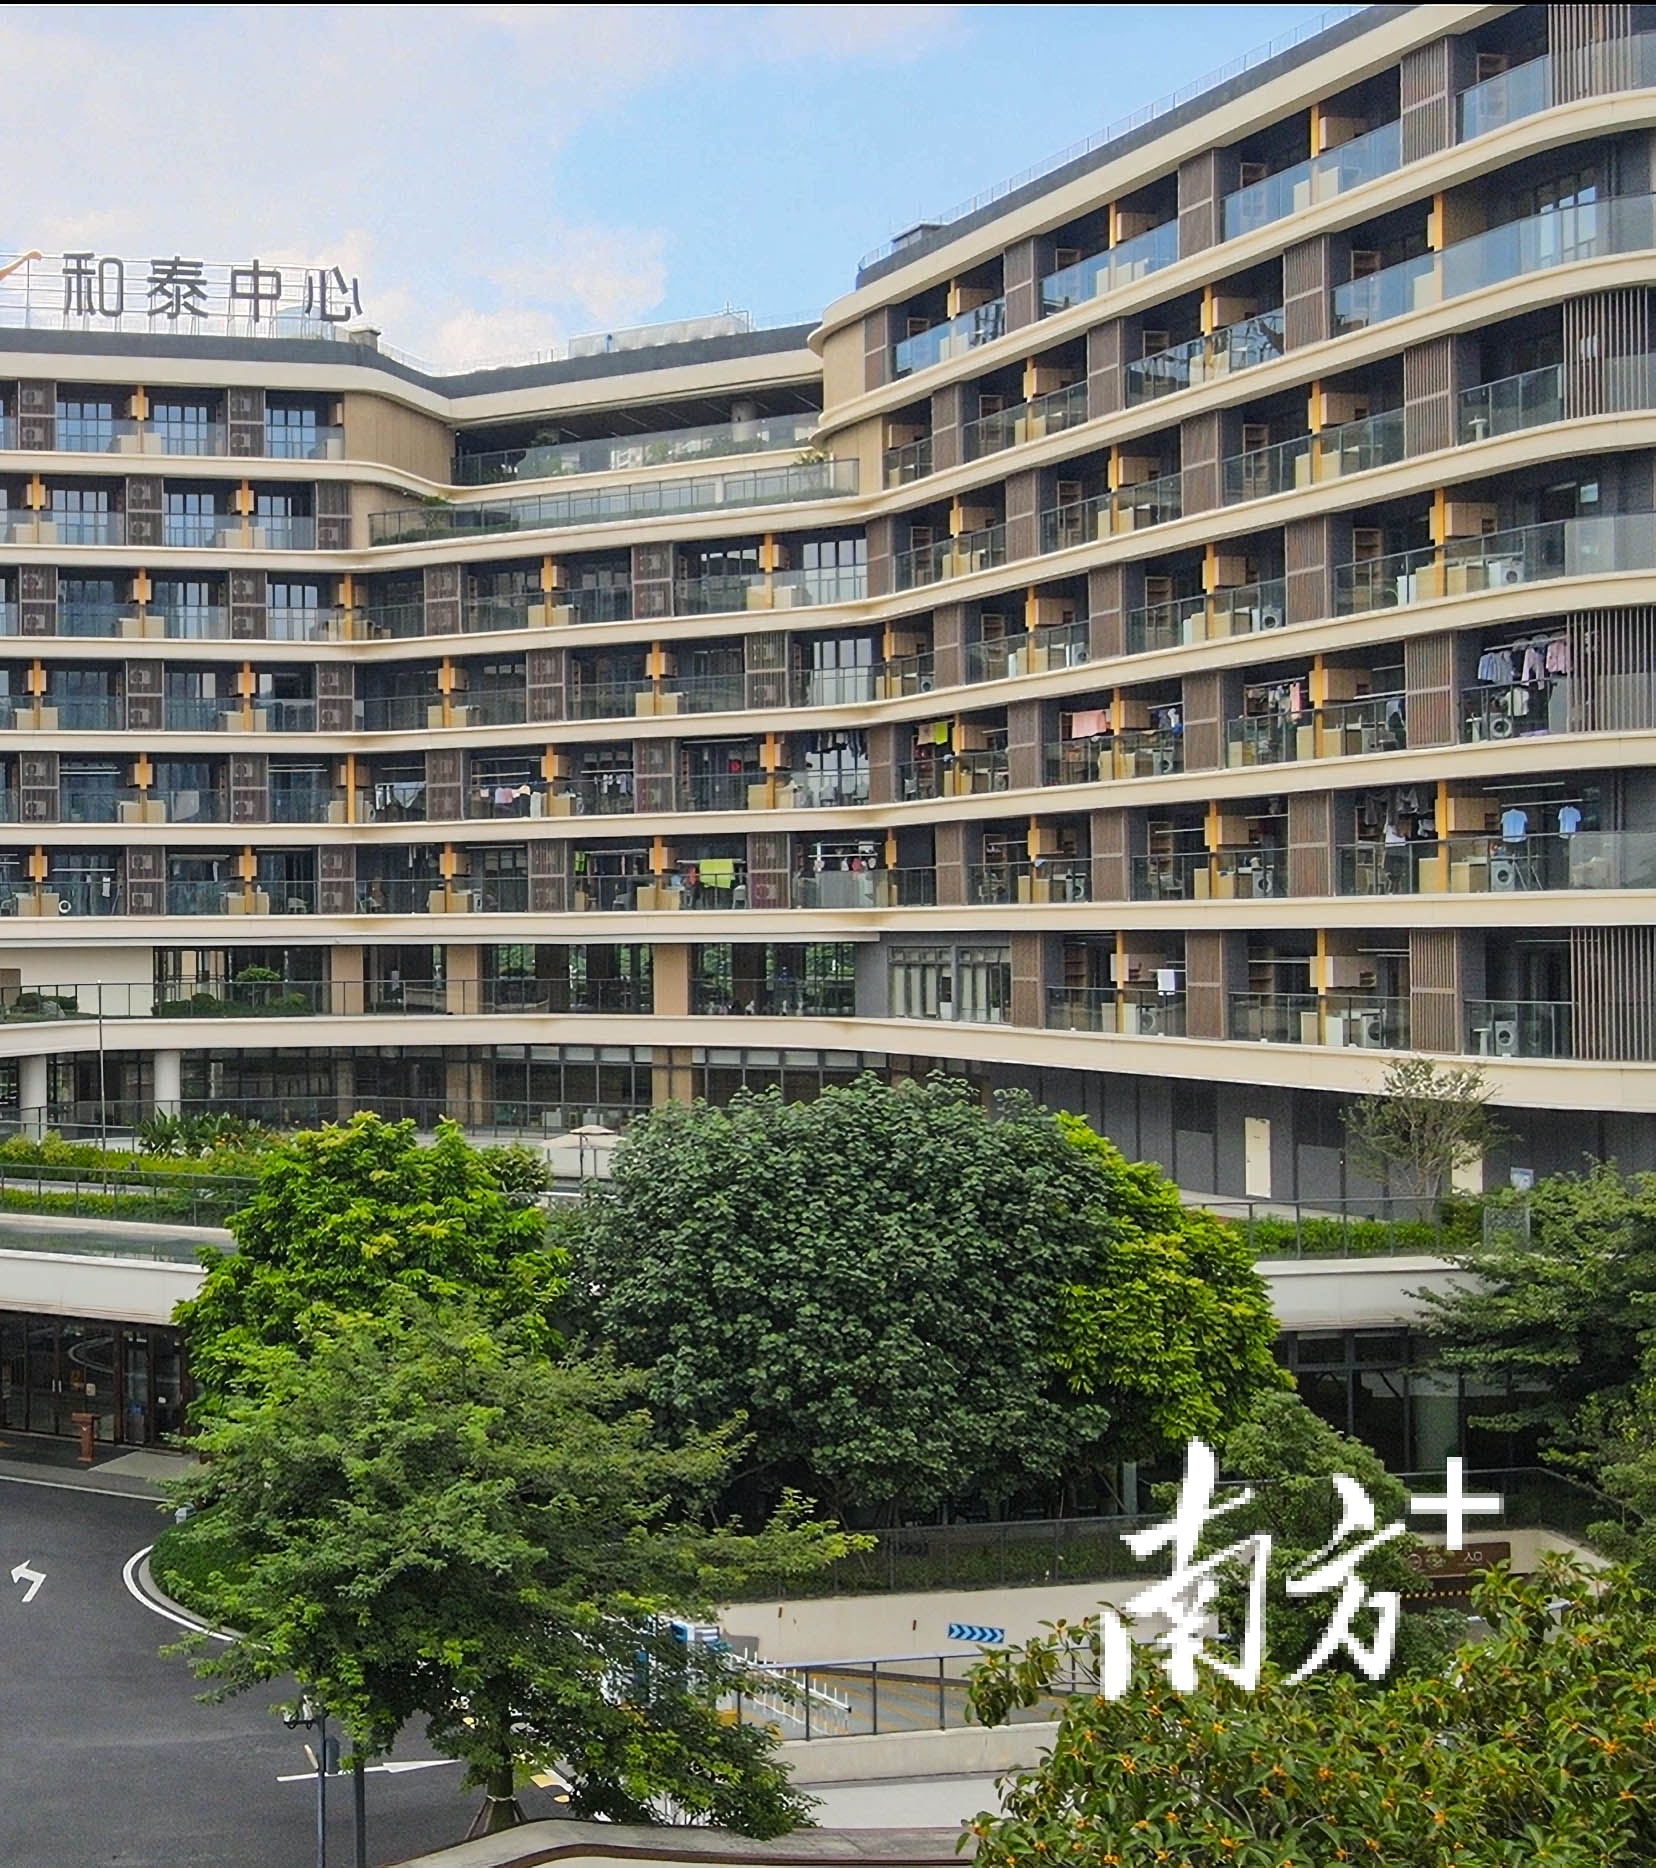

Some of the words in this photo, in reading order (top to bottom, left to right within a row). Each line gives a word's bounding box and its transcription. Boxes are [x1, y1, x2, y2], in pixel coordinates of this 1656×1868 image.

[63, 252, 362, 323] 和泰中心
[1464, 1551, 1483, 1562] 入口
